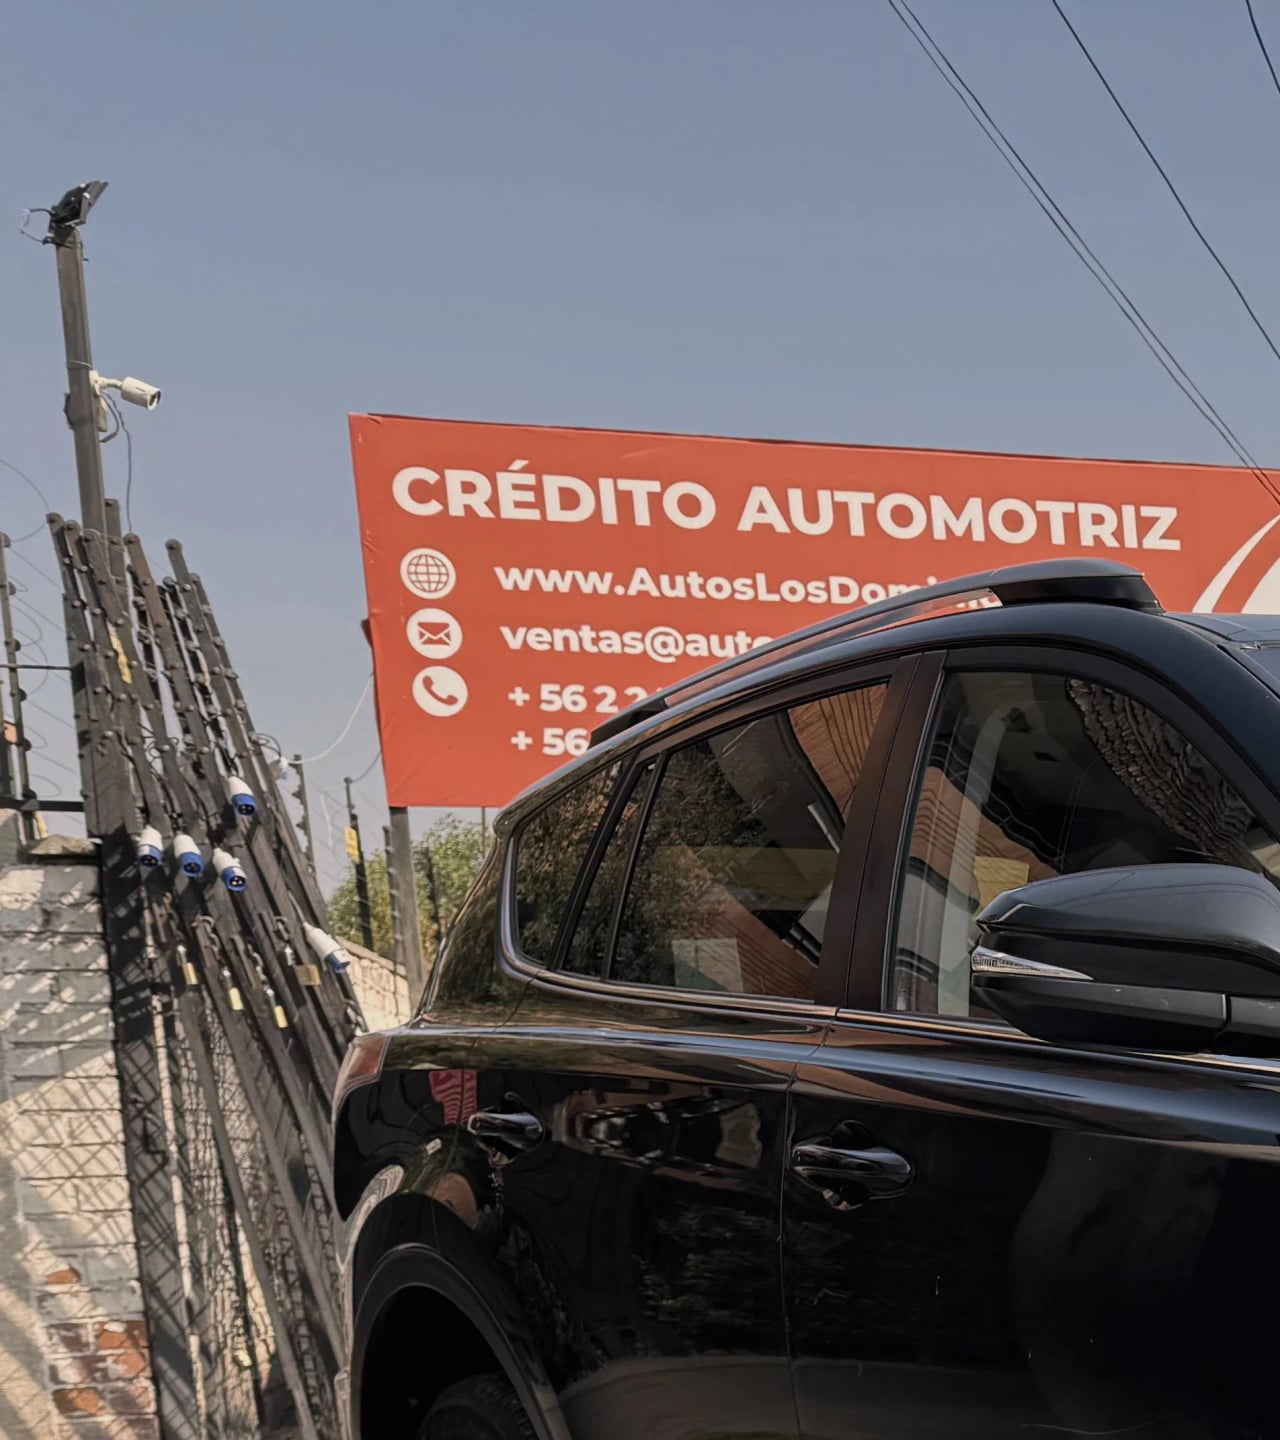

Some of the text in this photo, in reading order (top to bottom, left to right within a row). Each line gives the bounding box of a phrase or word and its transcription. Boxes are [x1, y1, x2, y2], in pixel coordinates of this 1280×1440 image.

[392, 460, 1181, 551] CRÉDITO AUTOMOTRIZ
[539, 683, 587, 712] 56
[593, 685, 619, 713] 2
[542, 728, 590, 756] 56
